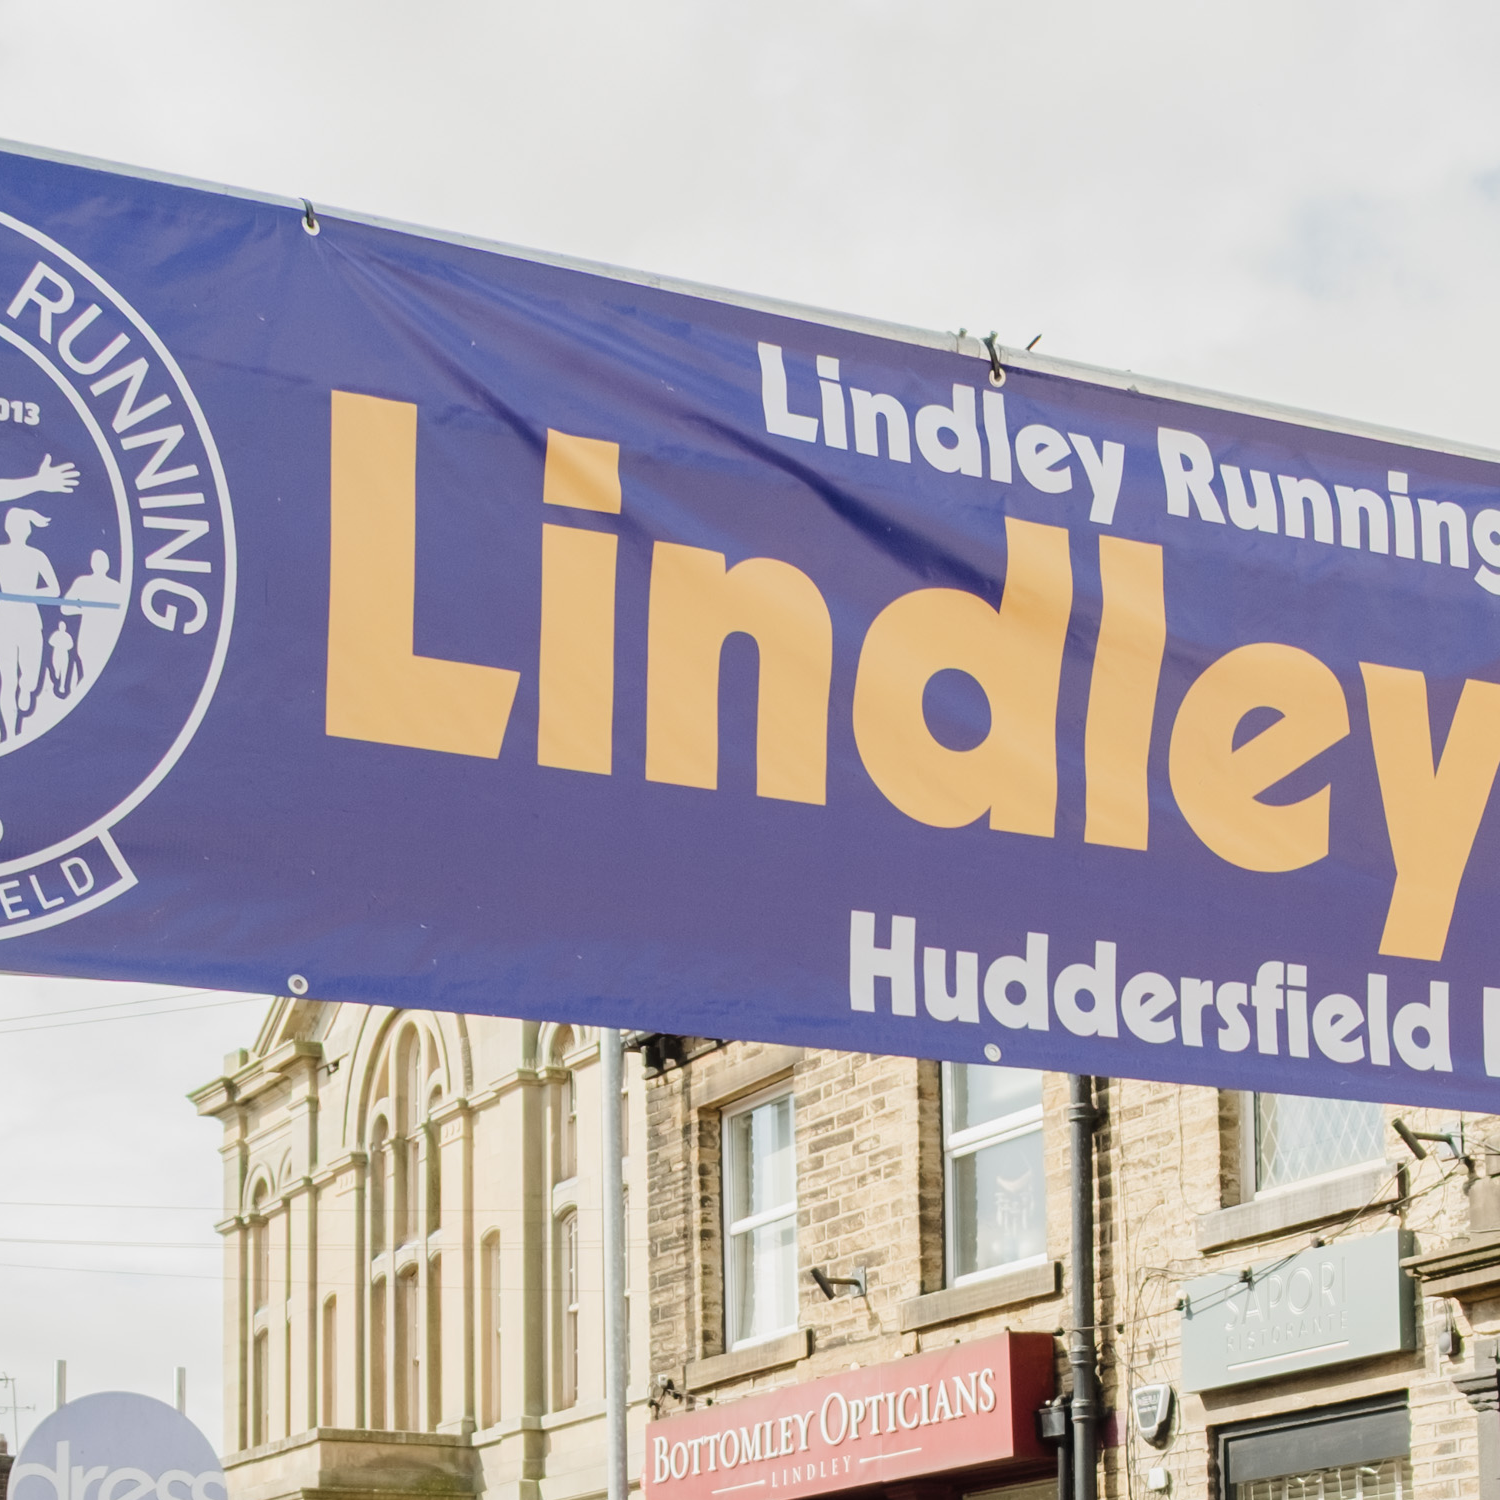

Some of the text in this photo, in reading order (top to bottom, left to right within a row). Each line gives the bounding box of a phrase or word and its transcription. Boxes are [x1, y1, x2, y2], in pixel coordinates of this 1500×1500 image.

[7, 261, 213, 637] RUNNING
[757, 341, 1126, 524] Lindley
[848, 909, 1453, 1072] Huddersfield
[1223, 1256, 1348, 1331] SAPORI
[1225, 1310, 1349, 1354] RISTORANTE
[651, 1366, 998, 1485] BOTTOMLEY OPTICIANS
[771, 1455, 852, 1489] LINDLEY
